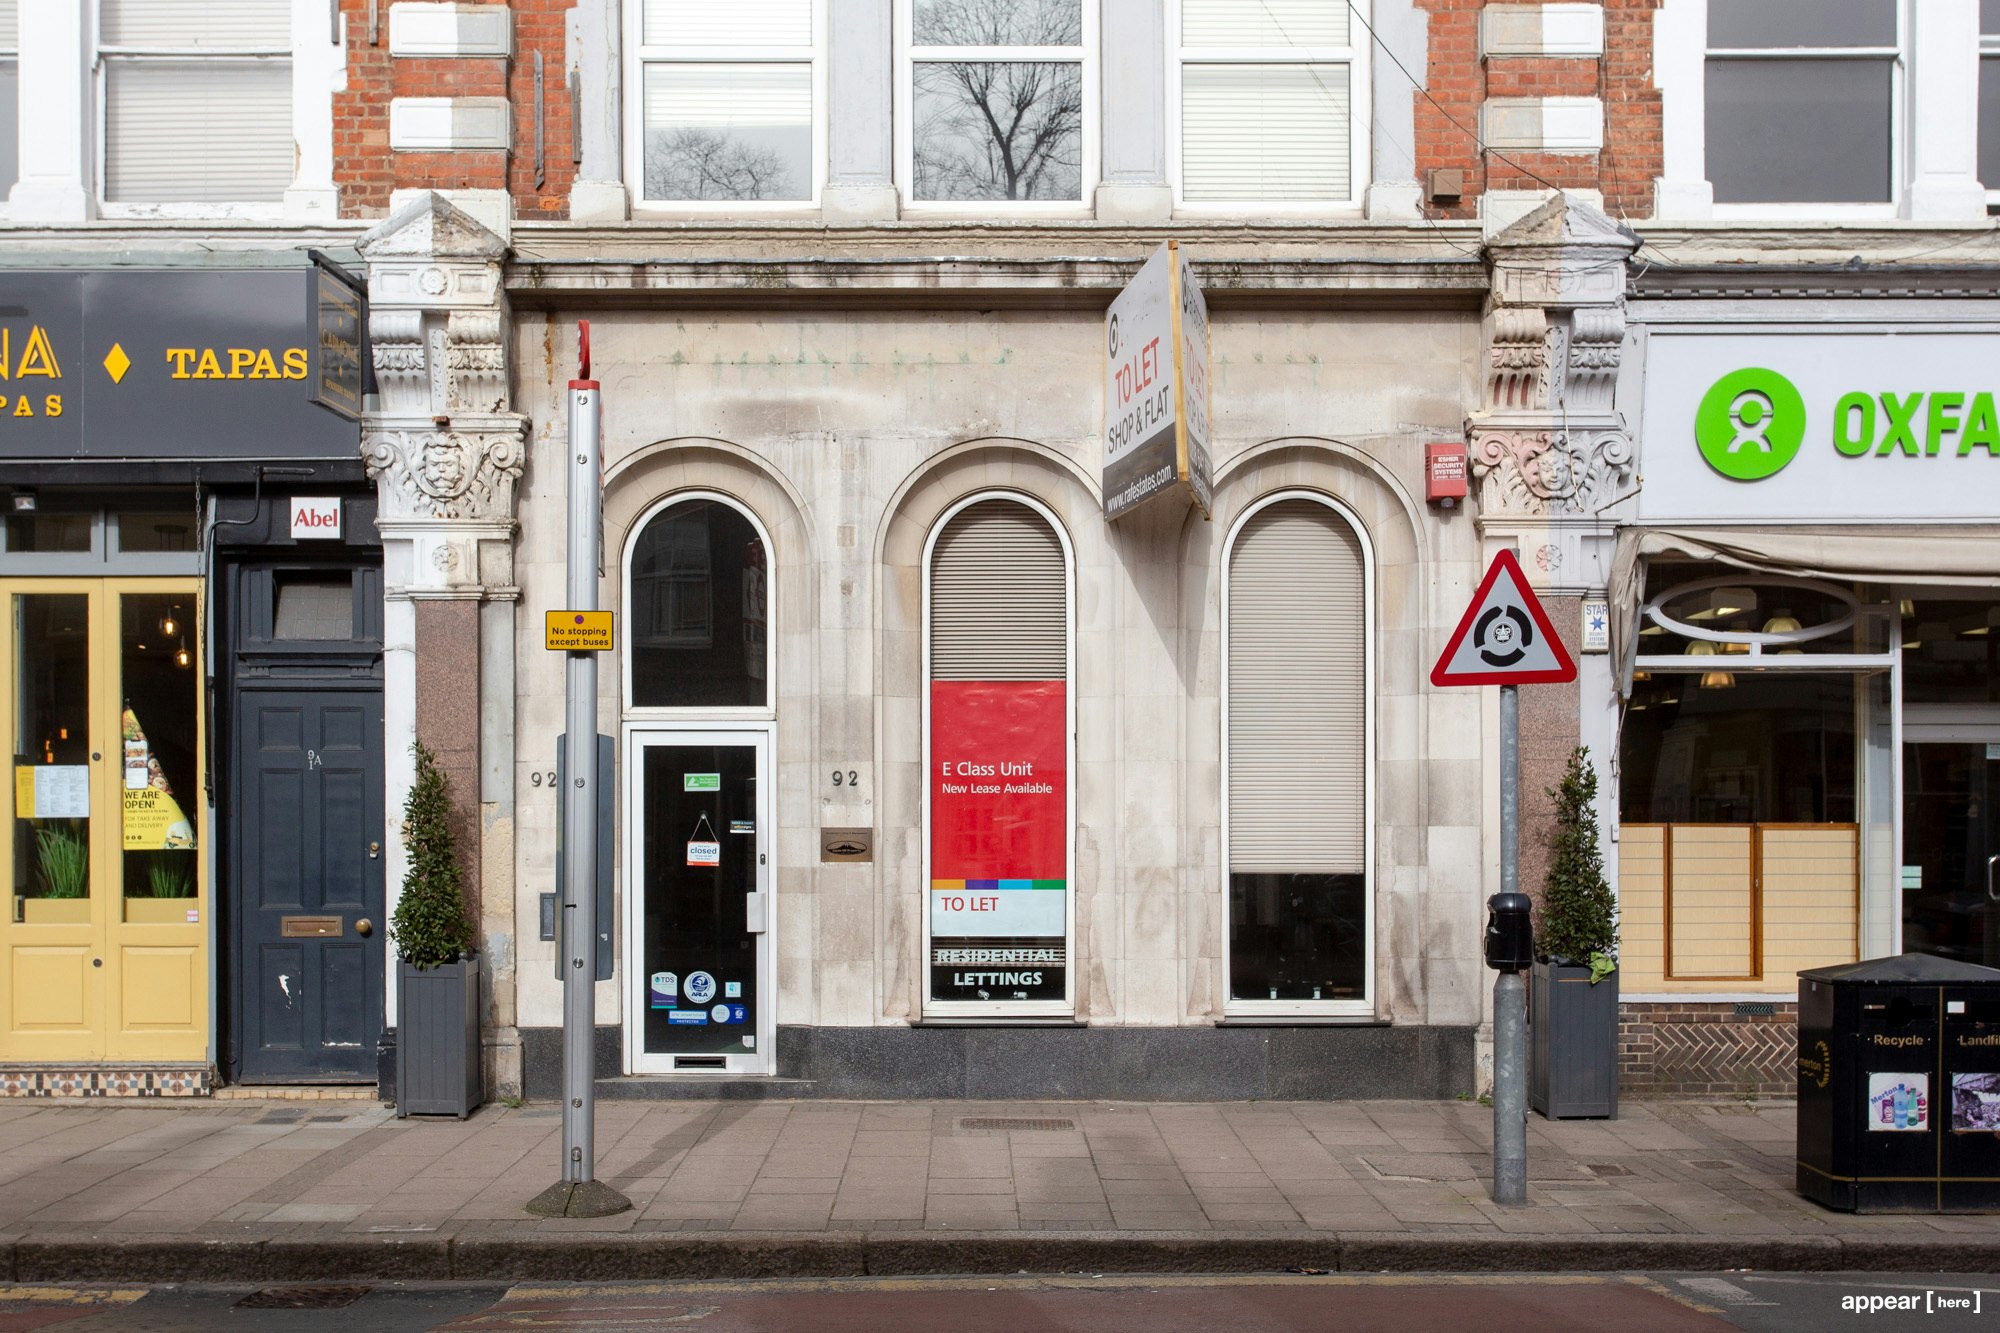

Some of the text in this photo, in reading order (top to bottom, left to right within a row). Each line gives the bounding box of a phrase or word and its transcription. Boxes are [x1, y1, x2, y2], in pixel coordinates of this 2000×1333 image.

[0, 325, 62, 380] A
[166, 347, 308, 380] TAPAS
[1115, 336, 1160, 410] TO LET
[1108, 412, 1134, 454] SHOP
[1135, 406, 1143, 435] &
[1144, 384, 1169, 429] FLAT
[1833, 391, 2000, 457] OXFA
[1107, 464, 1172, 513] www.rafestates.com
[294, 508, 338, 527] Abel
[1586, 604, 1608, 615] STAR
[552, 627, 607, 637] No stopping
[549, 638, 609, 647] except buses
[942, 761, 1033, 776] E Class Unit
[531, 771, 557, 788] 92
[832, 770, 858, 787] 92
[124, 791, 160, 799] WE ARE
[942, 783, 1053, 794] New Lease Available
[124, 800, 155, 809] OPEN!
[690, 847, 717, 855] closed
[941, 898, 999, 912] TO LET
[936, 949, 1060, 963] RESIDENTIAL
[954, 973, 1043, 986] LETTINGS
[1873, 1034, 1924, 1048] Recycle
[1870, 1086, 1899, 1105] Merton
